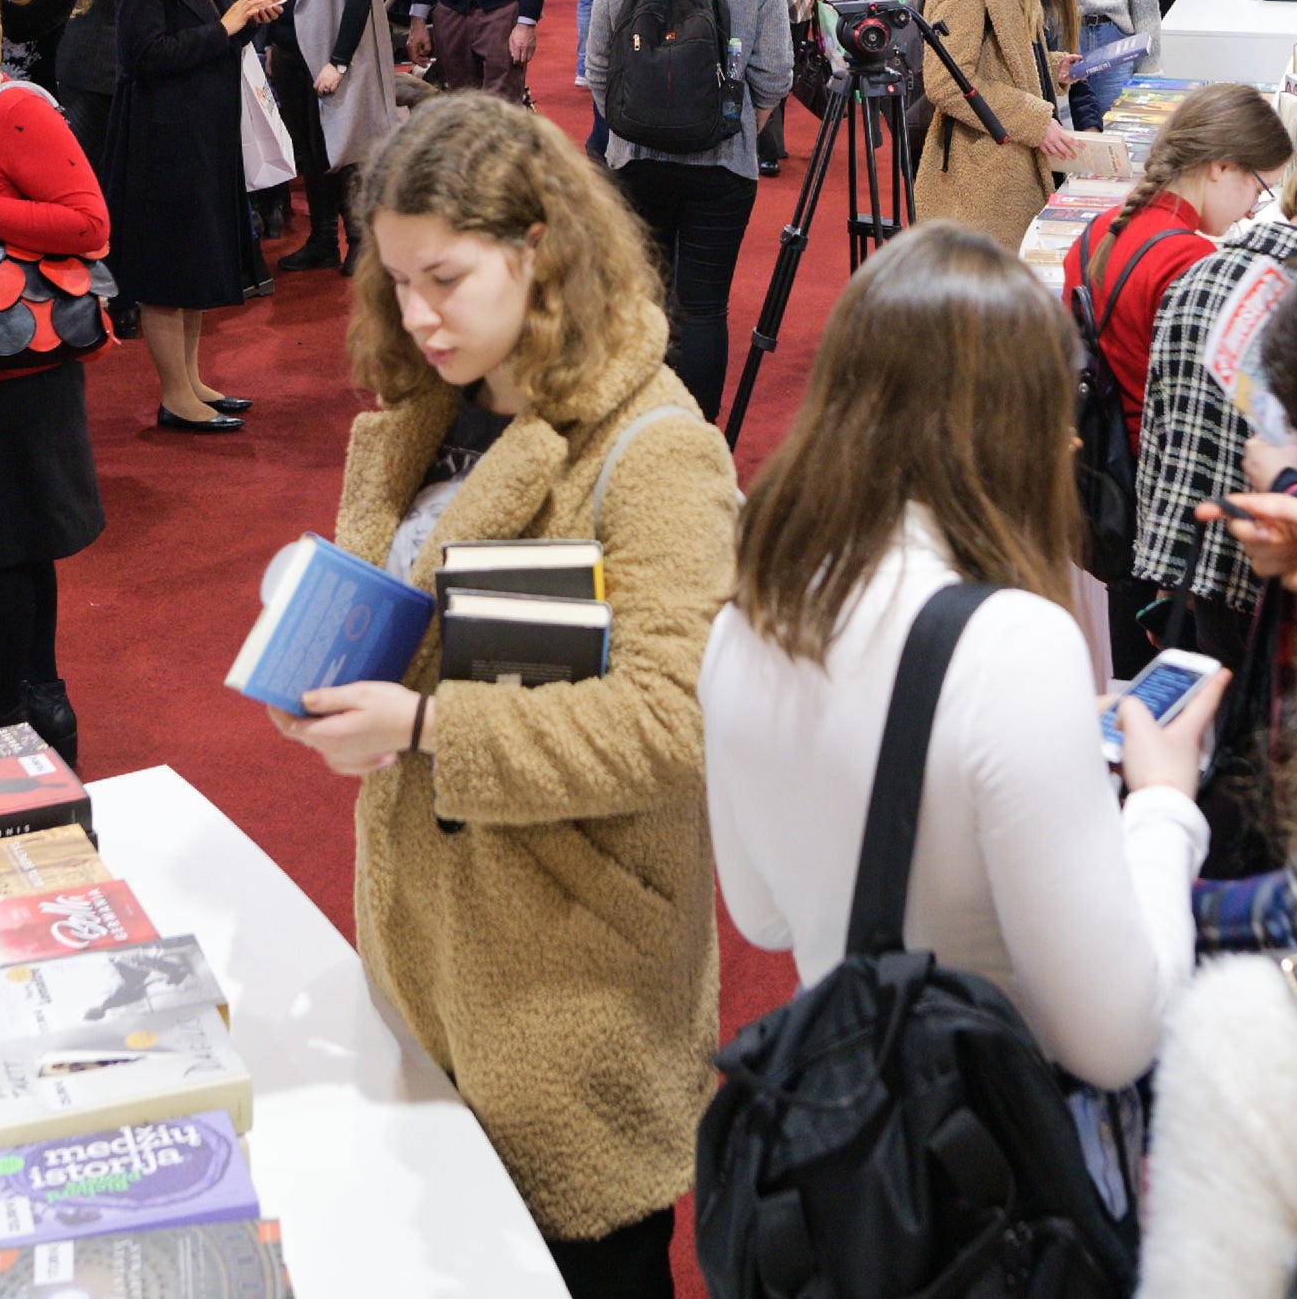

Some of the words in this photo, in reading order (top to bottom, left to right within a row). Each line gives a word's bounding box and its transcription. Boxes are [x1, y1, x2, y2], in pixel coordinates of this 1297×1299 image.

[87, 887, 129, 942] GERMANIA
[44, 1119, 202, 1166] medžių
[28, 1144, 185, 1190] istorija
